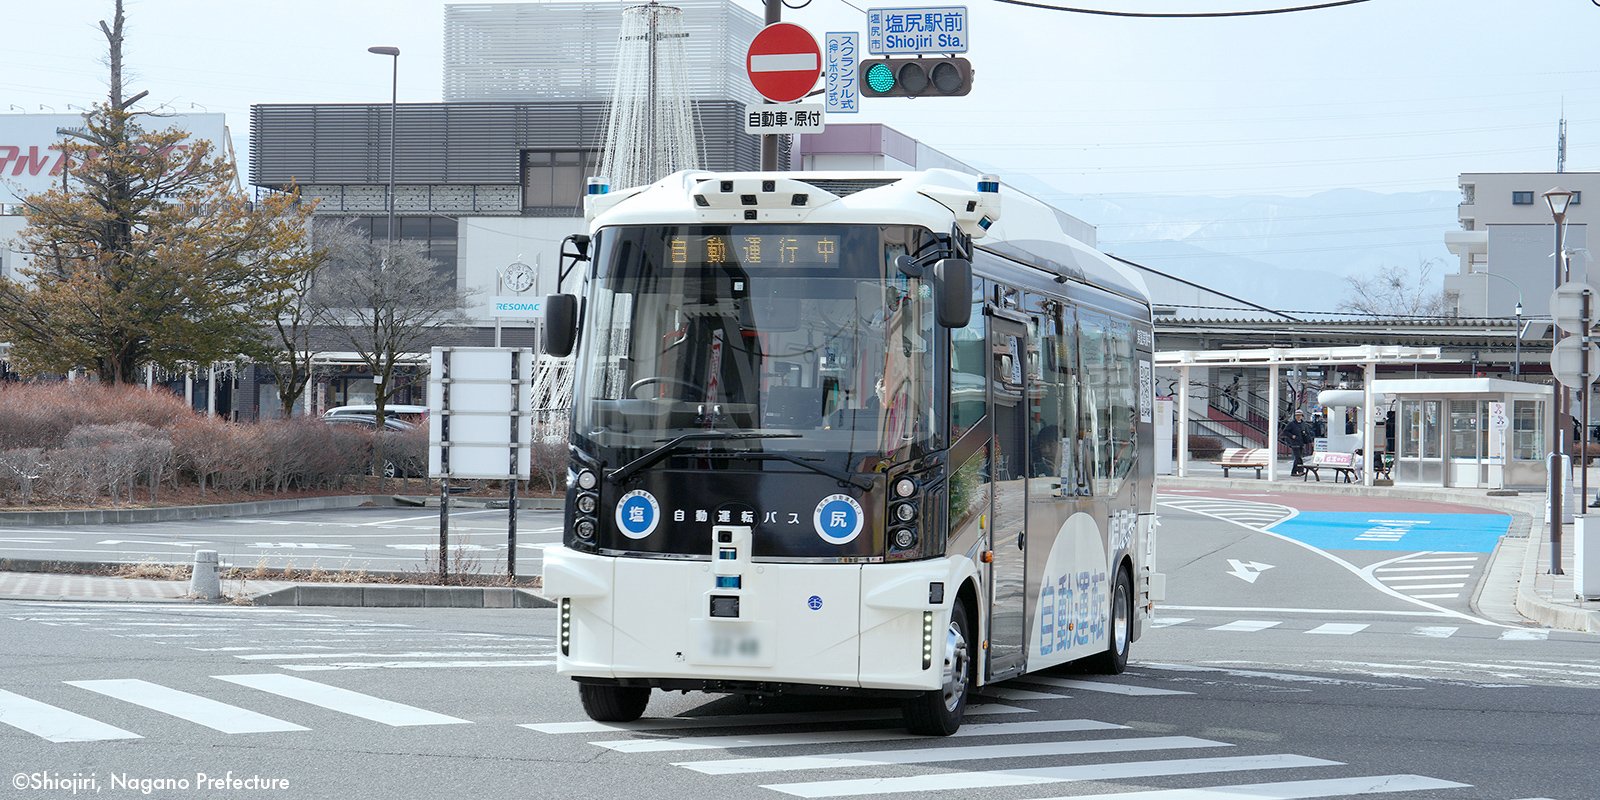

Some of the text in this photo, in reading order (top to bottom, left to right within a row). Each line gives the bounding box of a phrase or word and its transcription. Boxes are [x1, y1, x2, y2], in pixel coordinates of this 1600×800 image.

[870, 13, 881, 49] 塩尻市
[885, 12, 963, 33] 塩尻駅前
[886, 33, 964, 51] Shiojiri Sta.
[749, 110, 821, 128] 自動車・原付
[671, 236, 835, 263] 自動運行中
[496, 303, 540, 311] RESONAC
[629, 506, 645, 523] 塩
[673, 509, 800, 525] 自動運転バス
[830, 511, 847, 528] 尻
[1040, 568, 1106, 656] 自動運転
